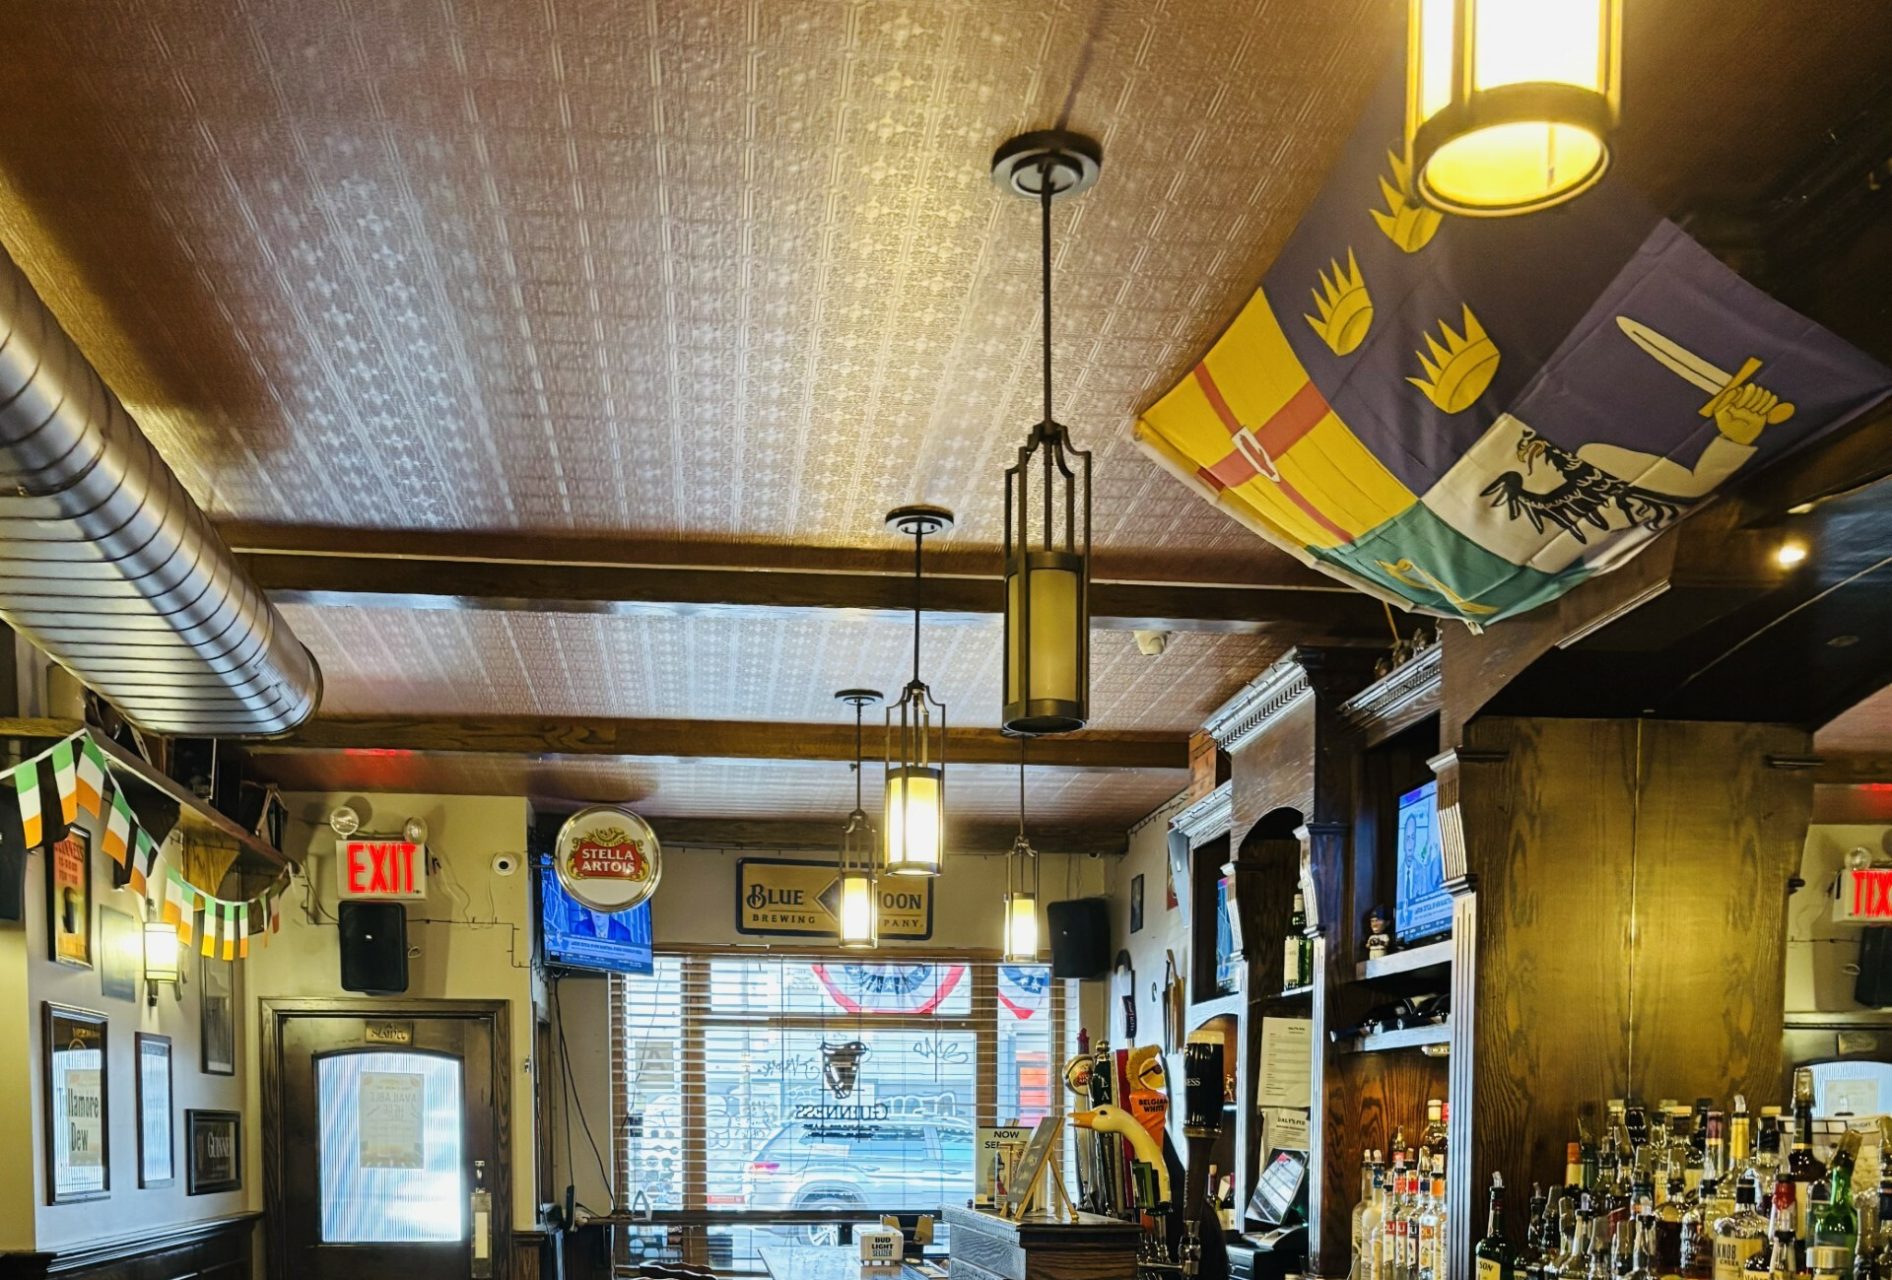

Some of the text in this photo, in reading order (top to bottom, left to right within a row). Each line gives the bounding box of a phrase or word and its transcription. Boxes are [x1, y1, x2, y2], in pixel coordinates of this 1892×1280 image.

[582, 848, 634, 860] STELLA
[347, 843, 416, 893] EXIT
[582, 861, 635, 872] ARTOIS
[746, 884, 922, 910] BLUE OON
[752, 914, 925, 928] BREWING PANY.
[71, 1122, 89, 1152] Dew
[994, 1130, 1020, 1139] NOW
[1717, 1243, 1737, 1259] KNOB
